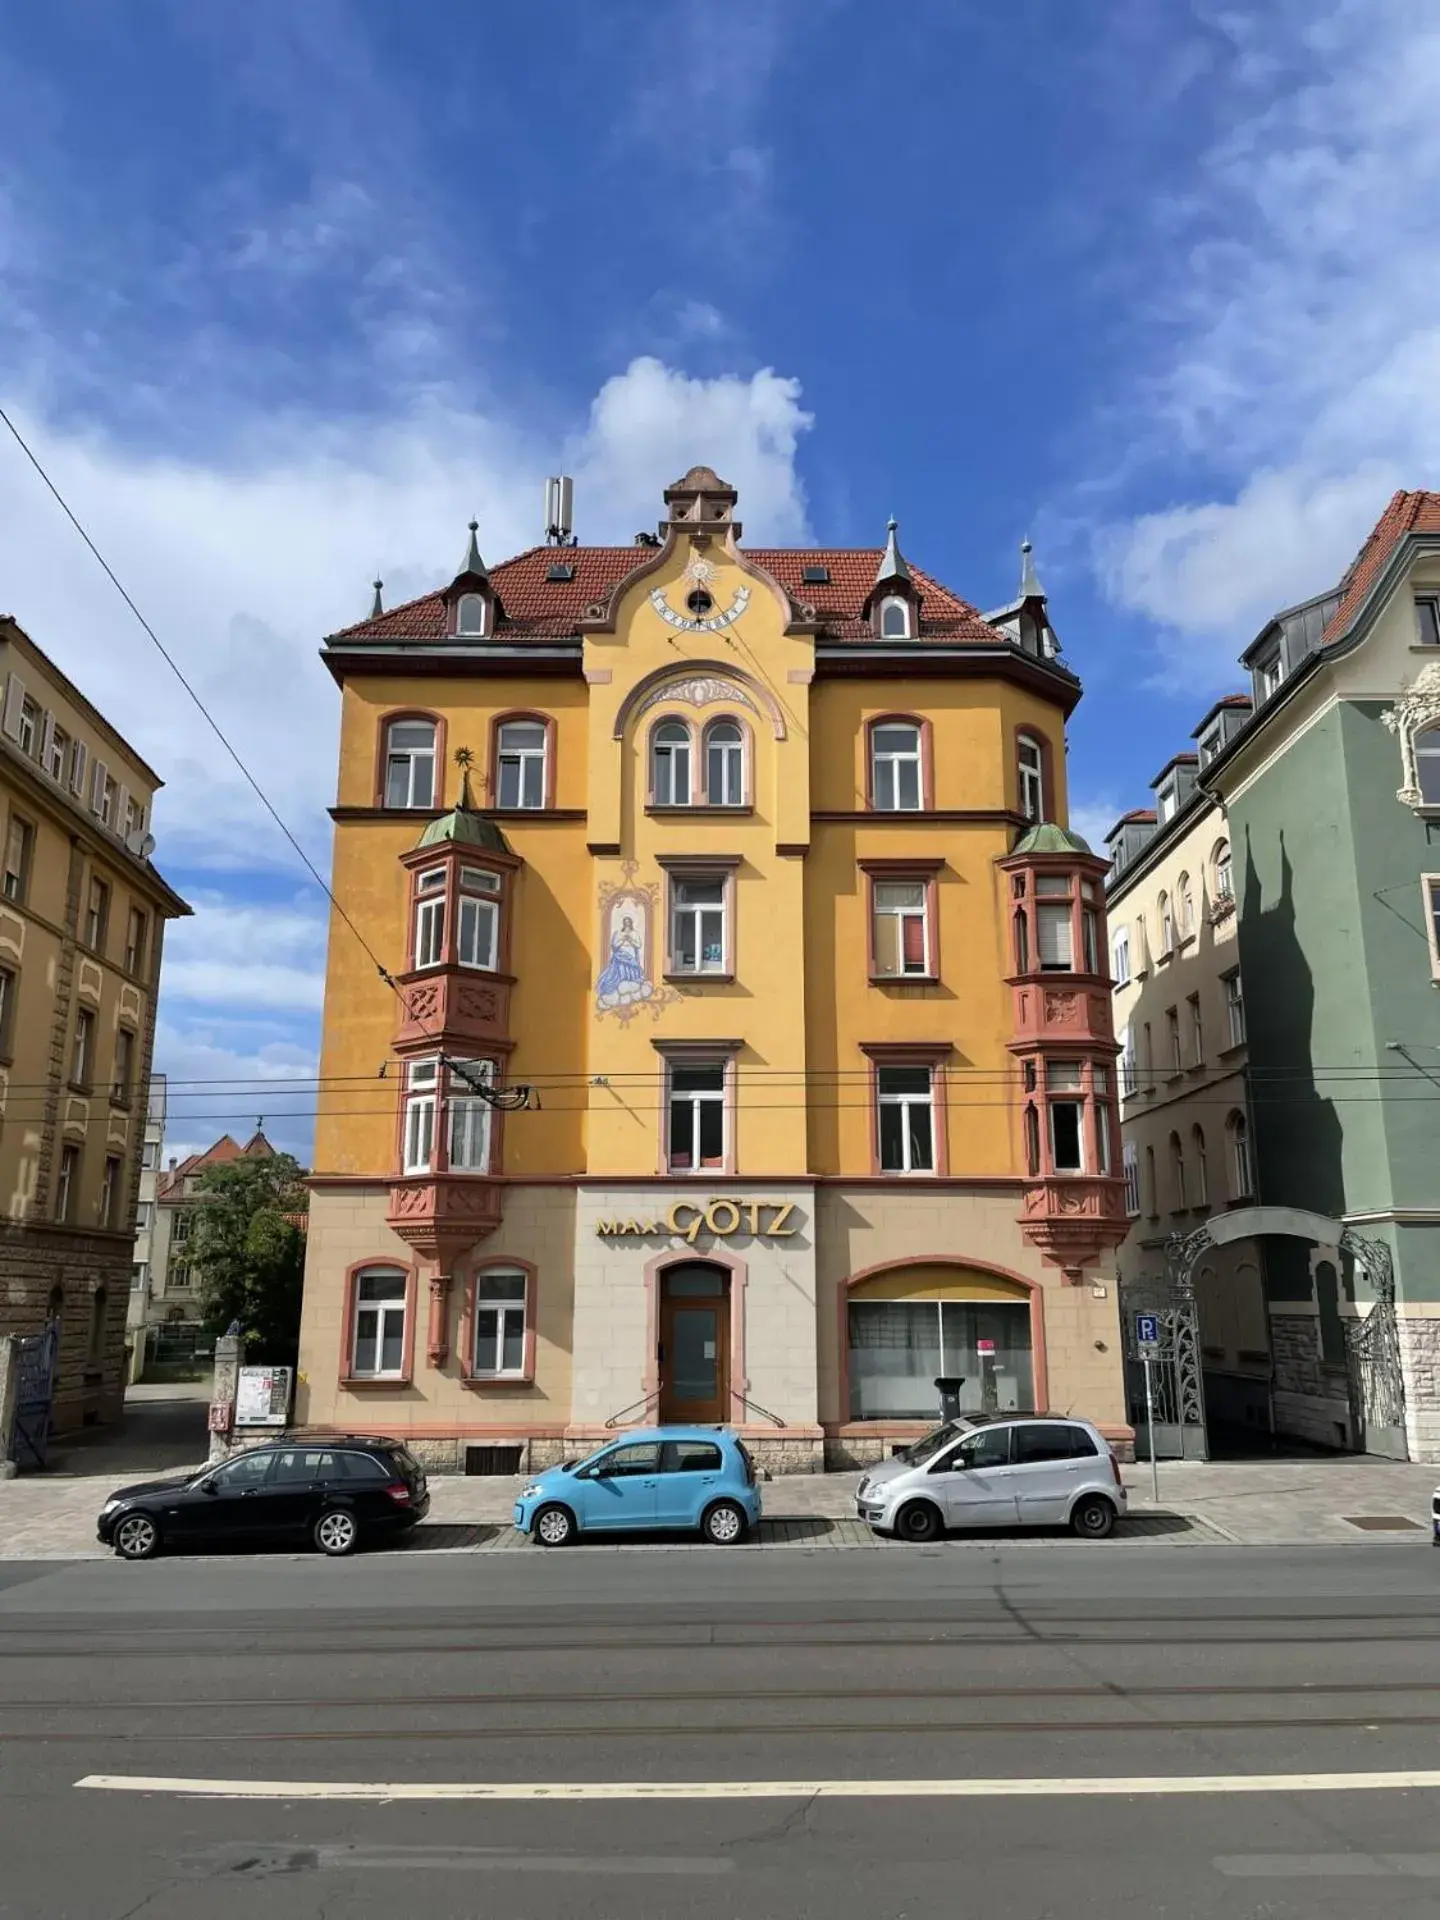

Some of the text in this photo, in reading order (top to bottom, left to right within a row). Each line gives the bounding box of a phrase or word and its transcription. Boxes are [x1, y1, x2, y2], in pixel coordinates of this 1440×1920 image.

[596, 1197, 798, 1243] MAX GÖTZ
[1141, 1319, 1153, 1339] P
